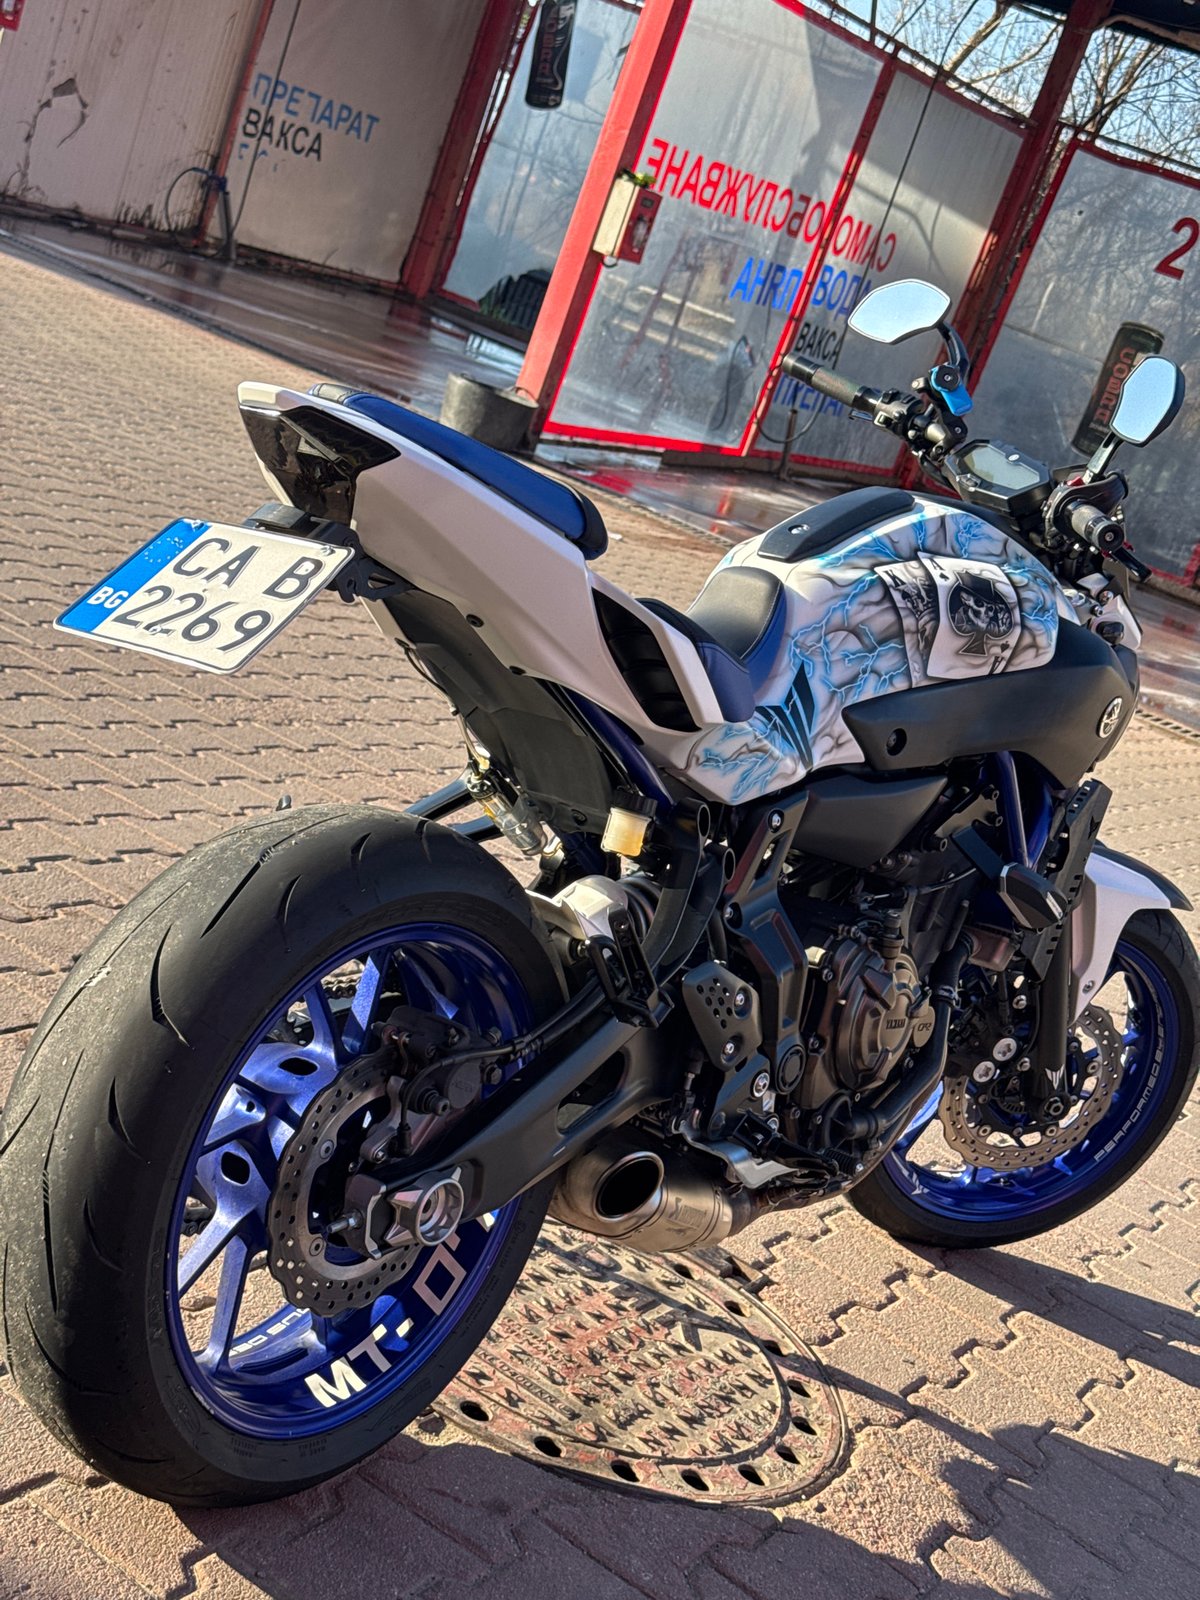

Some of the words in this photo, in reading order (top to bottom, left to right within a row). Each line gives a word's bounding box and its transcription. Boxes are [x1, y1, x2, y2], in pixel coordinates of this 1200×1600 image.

[242, 108, 322, 162] ВАКСА
[1153, 216, 1199, 282] 2
[812, 264, 873, 323] ВОД
[794, 322, 843, 362] ВАКСА
[87, 586, 129, 609] BG
[173, 537, 261, 591] CA
[262, 556, 325, 600] B
[111, 585, 272, 652] 2269
[1094, 1063, 1160, 1162] PERFORMED
